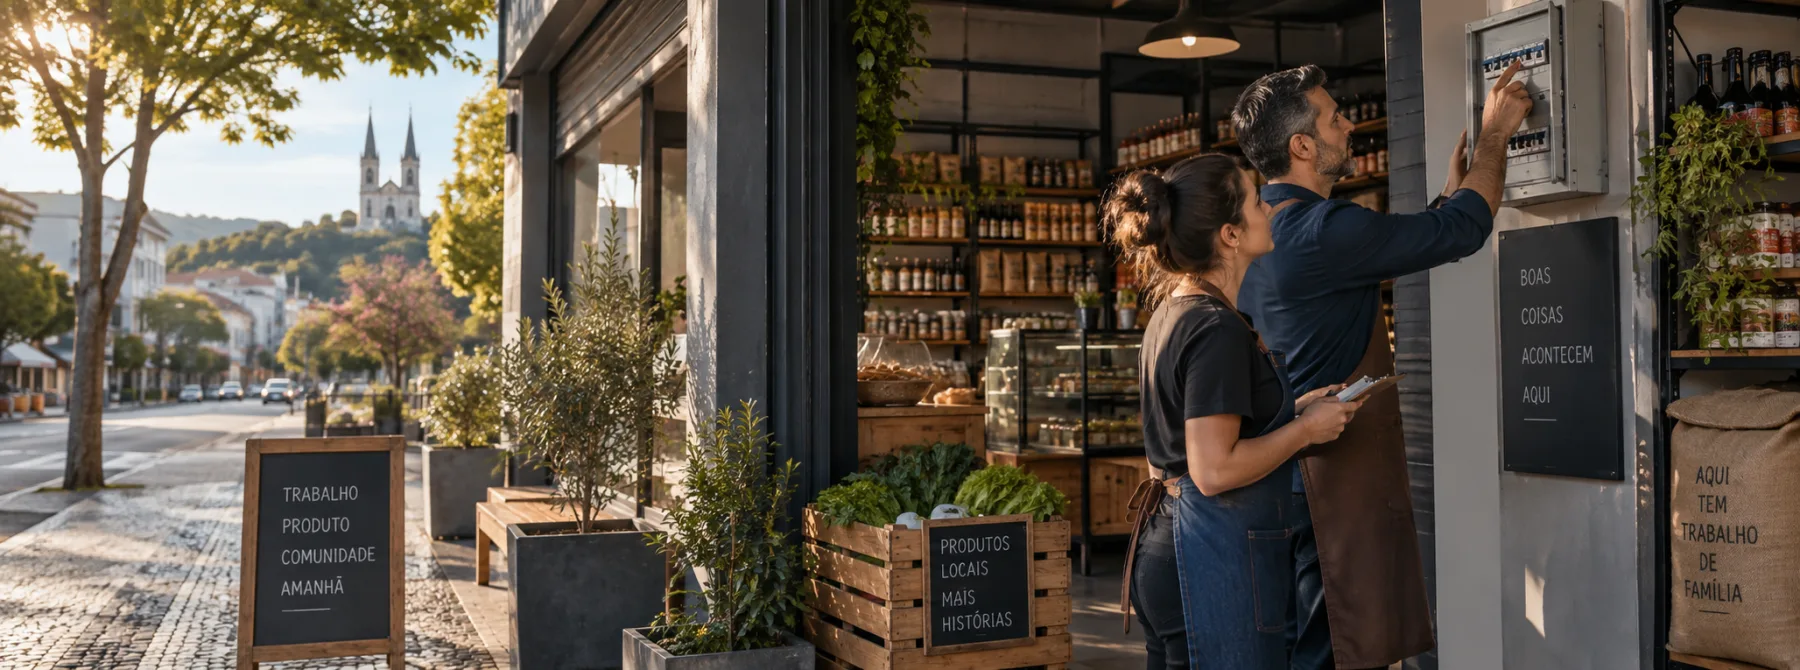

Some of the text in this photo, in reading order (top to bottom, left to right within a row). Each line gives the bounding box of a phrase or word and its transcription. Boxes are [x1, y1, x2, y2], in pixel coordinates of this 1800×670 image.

[1520, 267, 1551, 286] BOAS
[1521, 305, 1564, 325] COISAS
[1521, 345, 1594, 365] ACONTECEM
[1522, 386, 1551, 405] AQUI
[1695, 466, 1729, 487] AQUI
[283, 485, 359, 502] TRABALHO
[1697, 495, 1727, 514] TEM
[282, 517, 350, 534] PRODUTO
[1681, 522, 1759, 545] TRABALHO
[941, 535, 1010, 555] PRODUTOS
[281, 546, 376, 565] COMUNIDADE
[1699, 552, 1717, 572] DE
[941, 560, 989, 579] LOCAIS
[281, 576, 344, 596] AMANHÃ
[1684, 578, 1743, 603] FAMÍLIA
[942, 588, 976, 607] MAIS
[942, 610, 1013, 632] HISTÓRIAS
